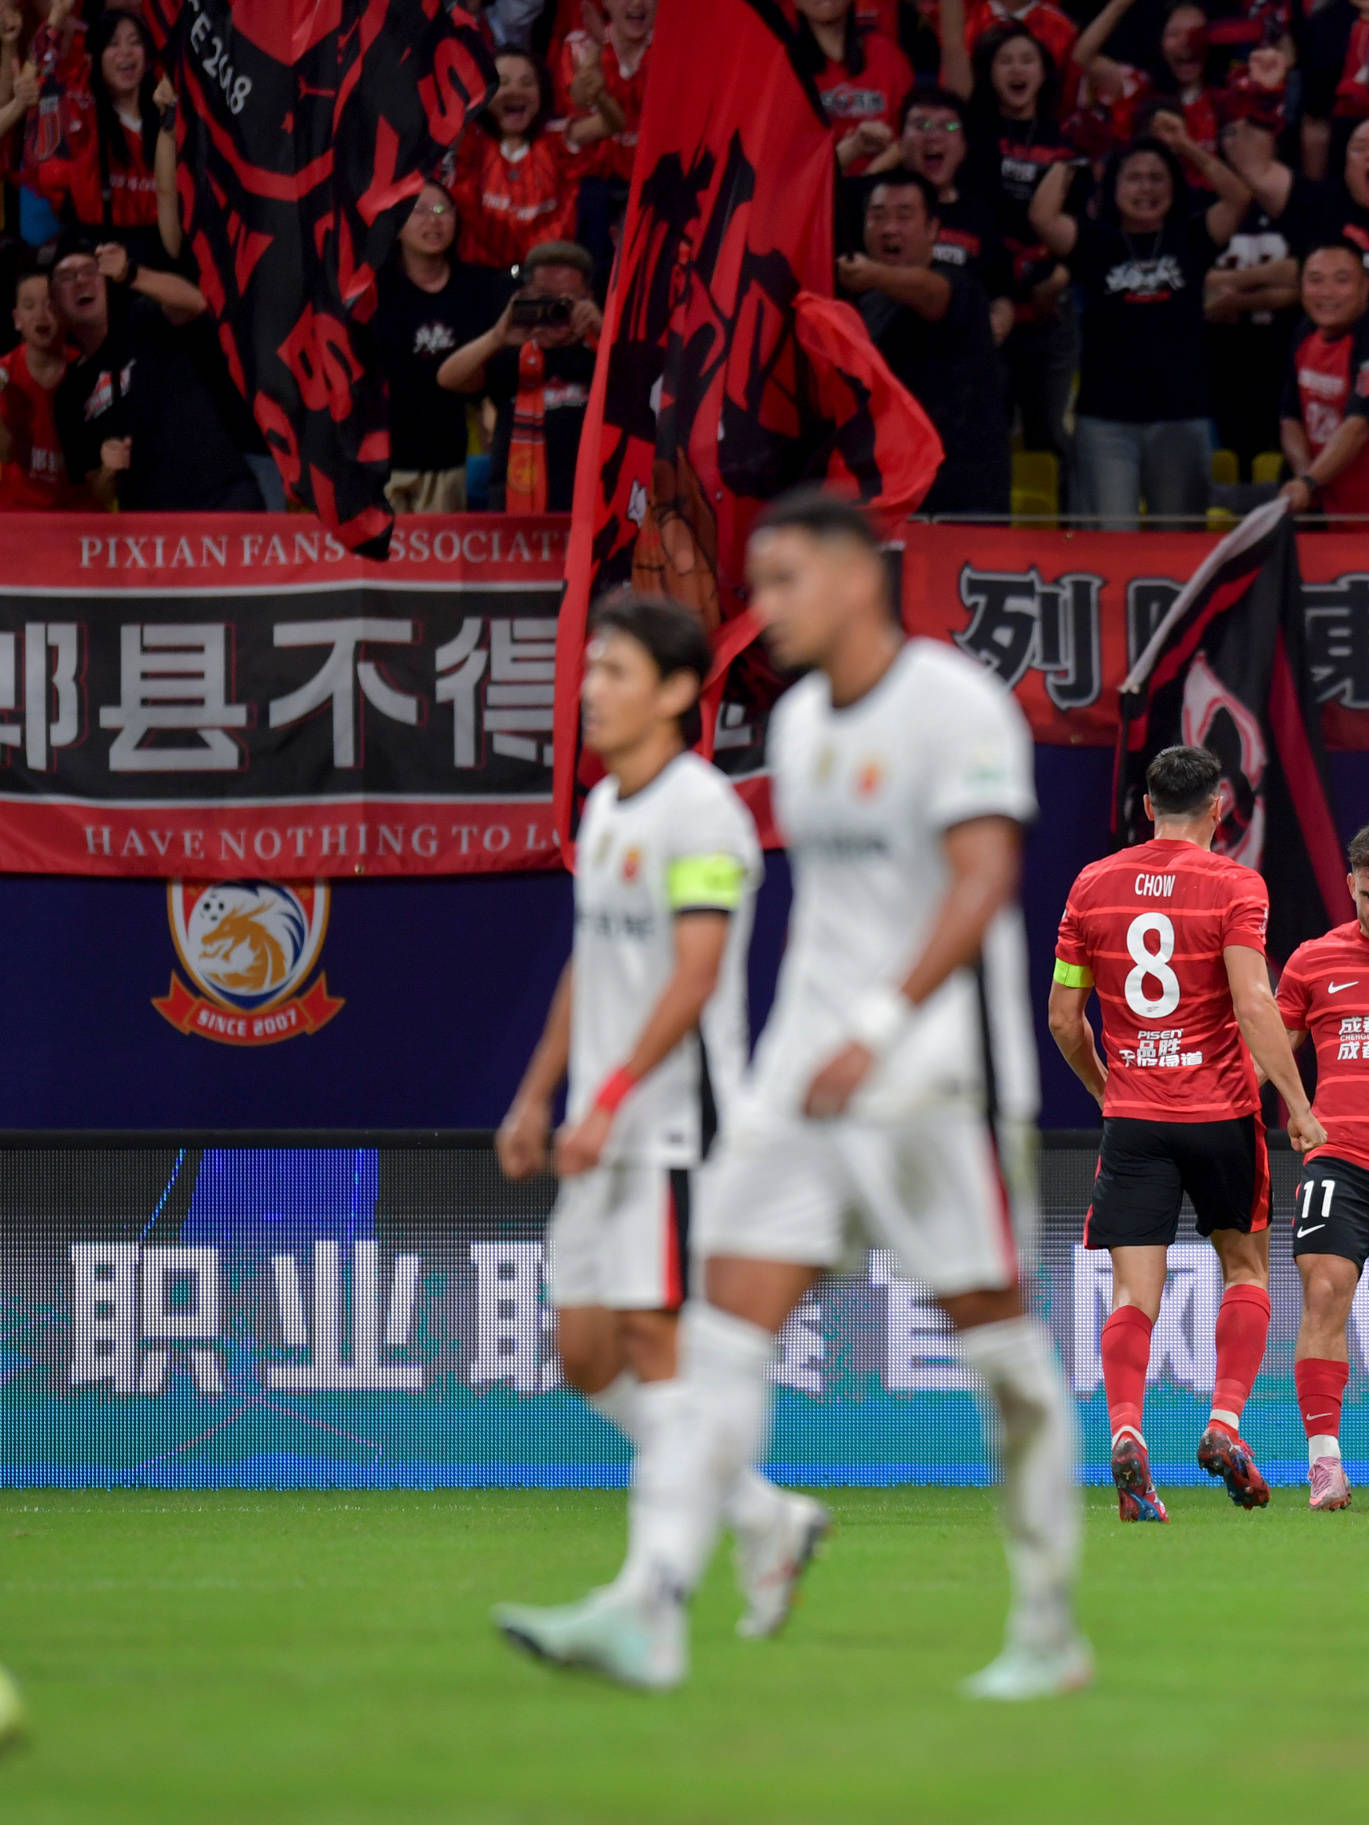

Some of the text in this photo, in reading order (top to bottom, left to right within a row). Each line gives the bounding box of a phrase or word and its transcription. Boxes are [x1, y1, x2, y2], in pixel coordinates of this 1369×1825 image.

[80, 527, 570, 568] PIXIAN FANS SSOCIAT
[85, 825, 205, 860] HAVE
[219, 822, 439, 862] NOTHING
[451, 825, 511, 854] TO
[1134, 873, 1176, 897] CHOW
[1124, 911, 1181, 1019] 8
[197, 1008, 298, 1037] SINCE 2007
[1301, 1179, 1337, 1220] 11
[70, 1239, 1223, 1394] 职业网
